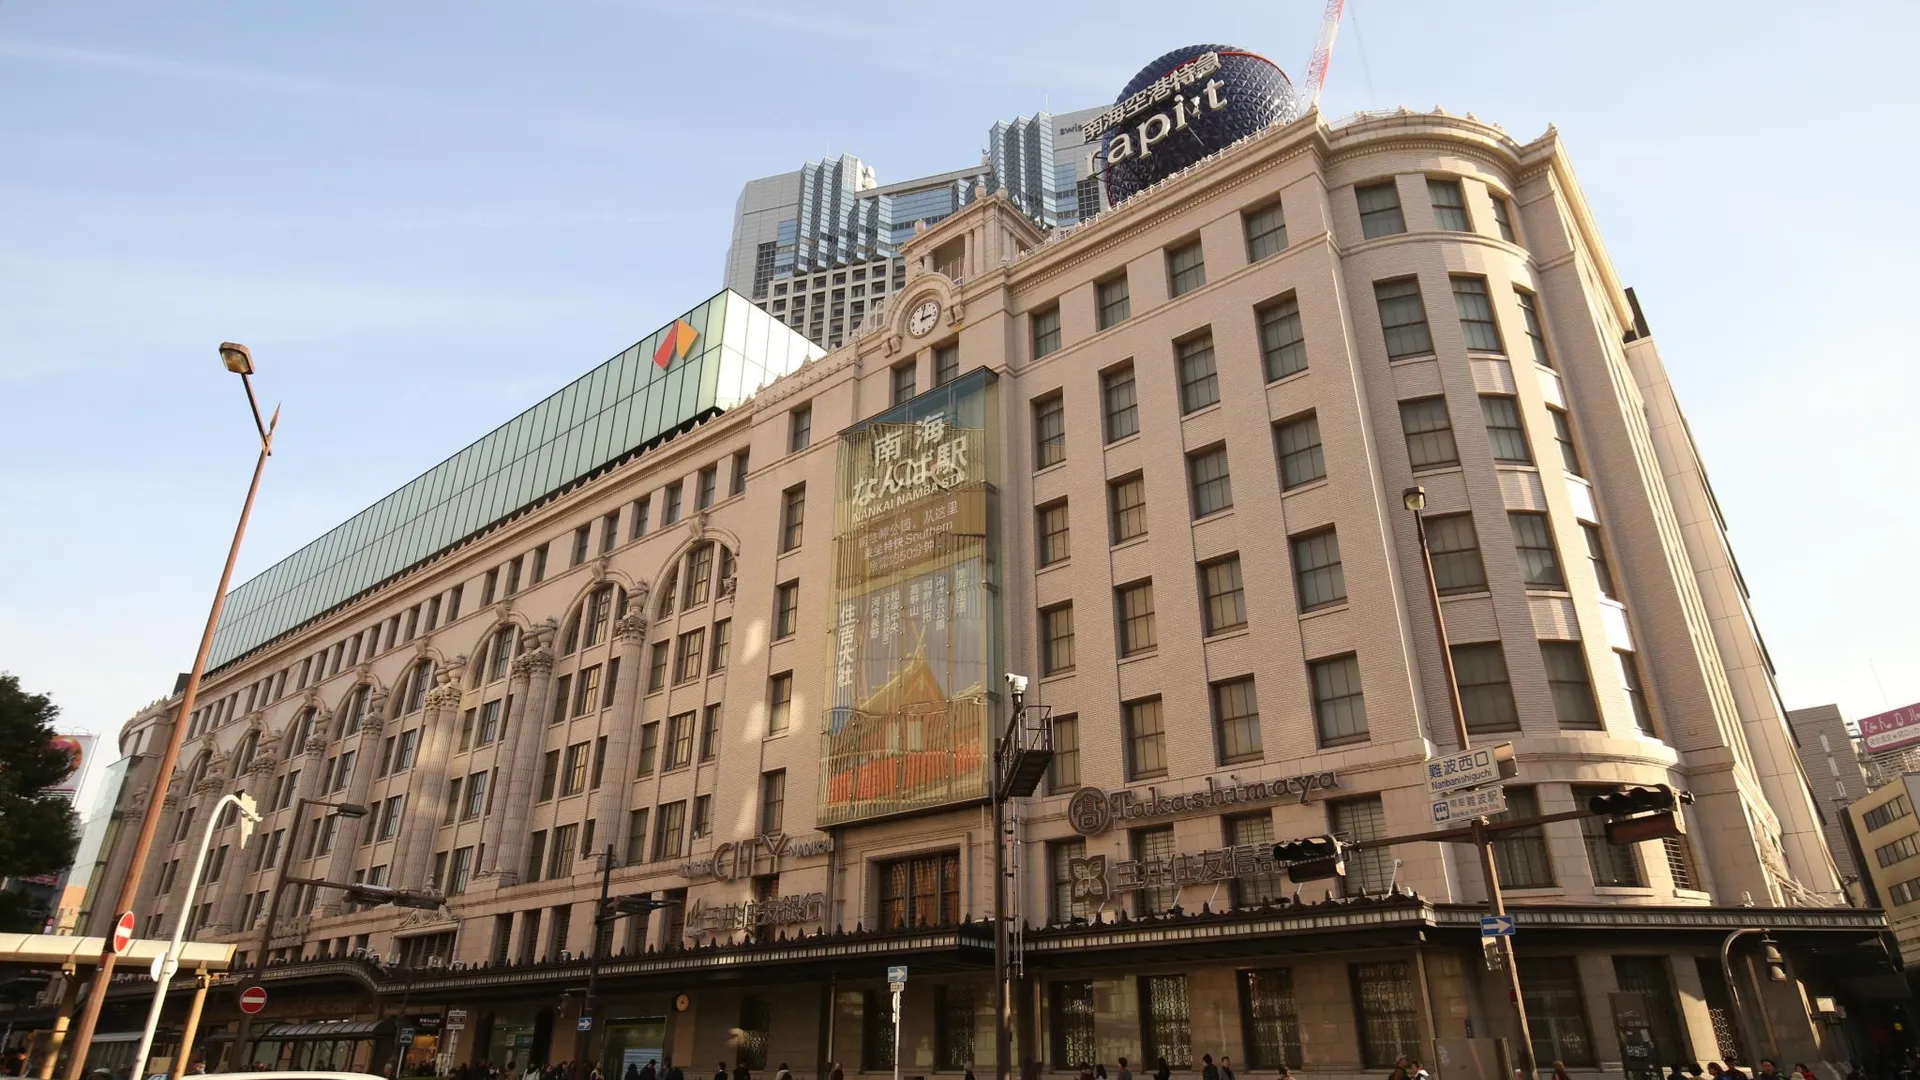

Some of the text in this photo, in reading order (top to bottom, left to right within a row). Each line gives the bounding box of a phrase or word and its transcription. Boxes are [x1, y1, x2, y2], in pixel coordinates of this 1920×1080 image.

[1083, 51, 1221, 143] 南海空港特急
[852, 435, 967, 507] なんば駅
[854, 498, 894, 522] NANKAI
[896, 484, 939, 507] NAMBA
[1428, 751, 1489, 779] 難波西口
[1431, 768, 1493, 791] Nanbanishiguchi
[1110, 769, 1339, 822] Takashimaya
[712, 833, 790, 882] CITY
[788, 838, 834, 860] NANKAI
